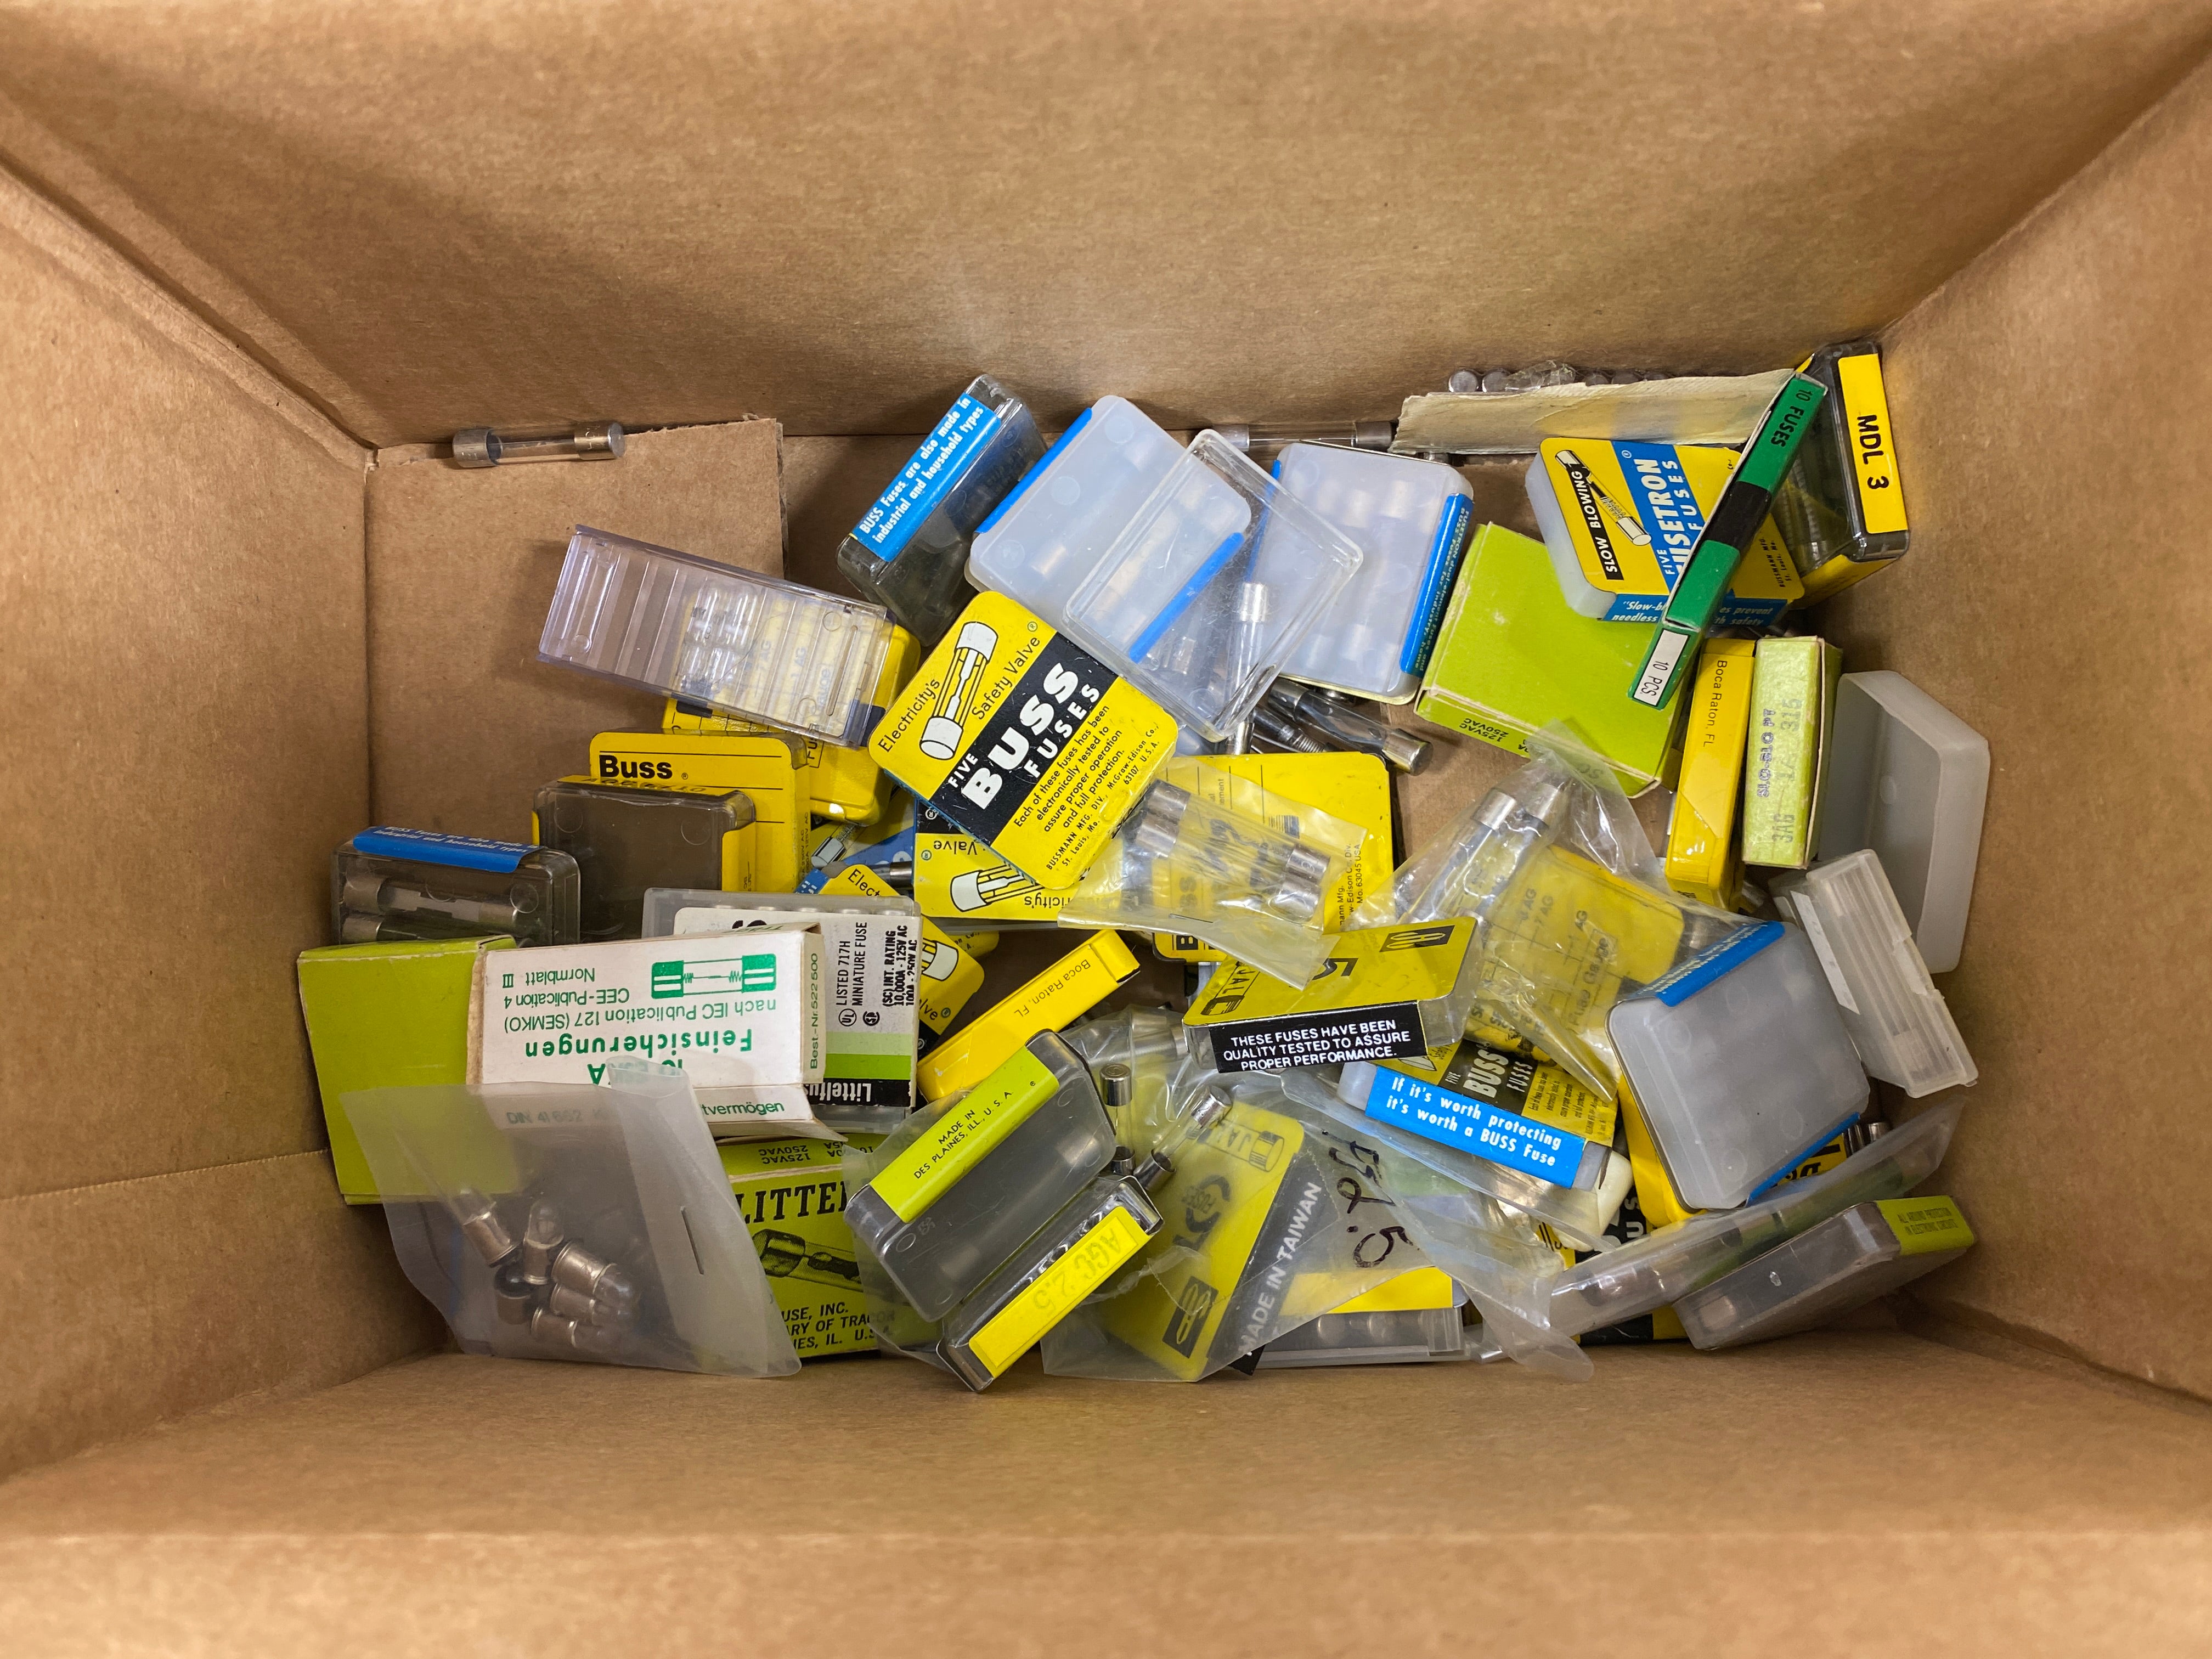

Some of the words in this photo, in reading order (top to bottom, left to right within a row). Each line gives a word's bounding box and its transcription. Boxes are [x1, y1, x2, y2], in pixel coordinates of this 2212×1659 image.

[1795, 390, 1814, 401] 10
[1770, 405, 1804, 448] FUSES
[1857, 415, 1883, 464] MDL
[860, 506, 884, 534] BUSS
[881, 480, 906, 506] Fuses
[905, 460, 921, 478] are
[919, 439, 938, 460] also
[937, 410, 961, 438] made
[957, 397, 971, 410] in
[872, 500, 911, 543] industrial
[909, 478, 927, 499] and
[925, 431, 963, 481] household
[960, 406, 984, 433] types
[1661, 460, 1703, 530] FUSES
[1867, 476, 1889, 489] 3
[1571, 471, 1600, 528] BLOWING
[1595, 537, 1617, 573] SLOW
[1657, 550, 1675, 574] FIVE
[1611, 613, 1658, 622] needless
[972, 676, 1012, 720] Safety
[1005, 636, 1041, 674] Valve
[1653, 662, 1669, 671] 10
[1712, 660, 1728, 689] Boca
[878, 678, 941, 752] Electricity's
[1705, 693, 1722, 729] Raton,
[962, 663, 1079, 809] BUSS
[1024, 684, 1099, 778] FUSES
[1459, 723, 1503, 742] 125VAC
[1464, 718, 1509, 737] 250VAC
[1703, 733, 1715, 747] FL
[599, 755, 673, 780] Buss
[947, 752, 978, 788] FIVE
[1015, 806, 1033, 827] Each
[1033, 793, 1042, 805] of
[1040, 771, 1060, 794] these
[1057, 748, 1078, 769] fuses
[1076, 730, 1092, 746] has
[1088, 705, 1109, 727] been
[1037, 765, 1080, 820] electronically
[1079, 737, 1101, 764] tested
[1100, 726, 1109, 736] to
[1044, 805, 1066, 832] assure
[1066, 773, 1089, 804] proper
[1090, 730, 1122, 771] operation
[1063, 809, 1078, 827] and
[1076, 793, 1090, 809] full
[1088, 750, 1125, 794] protection.
[1046, 832, 1077, 870] BUSSMANN
[1076, 814, 1093, 831] MFG.
[1107, 740, 1147, 789] McGraw-Edison
[1062, 857, 1073, 866] St.
[1070, 836, 1090, 854] Louis,
[1087, 821, 1100, 832] Mo.
[1124, 765, 1139, 785] 63107
[933, 840, 978, 855] Valve
[855, 922, 867, 947] FUSE
[897, 926, 907, 937] AC
[838, 941, 850, 965] 717H
[885, 931, 896, 965] RATING
[896, 940, 906, 961] 125V
[909, 940, 917, 951] AC
[526, 968, 595, 983] Normblatt
[852, 951, 865, 1006] MINIATURE
[883, 968, 894, 986] INT.
[1063, 960, 1091, 980] Boca
[516, 988, 629, 1007] CEE-Publication
[836, 969, 849, 1005] LISTED
[504, 996, 514, 1009] 4
[606, 1005, 696, 1022] Publication
[702, 1003, 730, 1018] IEC
[736, 998, 776, 1015] nach
[1014, 1005, 1029, 1017] FL
[504, 1012, 570, 1034] (SEMKO)
[574, 1011, 600, 1026] 127
[526, 1029, 752, 1058] Feinsicherungen
[1231, 1032, 1273, 1047] THESE
[1275, 1029, 1318, 1043] FUSES
[1321, 1023, 1357, 1037] HAVE
[1359, 1019, 1397, 1032] BEEN
[1223, 1045, 1276, 1061] QUALITY
[1279, 1040, 1330, 1054] TESTED
[1332, 1037, 1351, 1048] TO
[1353, 1031, 1411, 1047] ASSURE
[1241, 1056, 1291, 1071] PROPER
[1294, 1048, 1397, 1066] PERFORMANCE.
[1445, 1071, 1461, 1085] FIVE
[1463, 1049, 1509, 1098] BUSS
[1506, 1061, 1533, 1092] FUSES
[938, 1121, 963, 1144] MADE
[964, 1109, 975, 1120] IN
[1392, 1077, 1405, 1092] If
[1409, 1086, 1432, 1103] it's
[1441, 1096, 1482, 1121] worth
[1488, 1114, 1562, 1152] protecting
[1387, 1095, 1409, 1114] it's
[1418, 1110, 1459, 1132] worth
[1464, 1126, 1474, 1138] a
[1481, 1131, 1517, 1152] BUSS
[1523, 1146, 1556, 1167] Fuse
[758, 1145, 809, 1156] 250VAC
[762, 1153, 811, 1164] 125VAC
[914, 1163, 930, 1179] DES
[1074, 1230, 1120, 1280] AGC
[1238, 1293, 1276, 1357] MADE
[1267, 1266, 1287, 1291] IN
[1277, 1182, 1322, 1260] TAIWAN
[821, 1301, 848, 1315] INC.
[815, 1318, 834, 1332] OF
[826, 1334, 842, 1346] IL.
